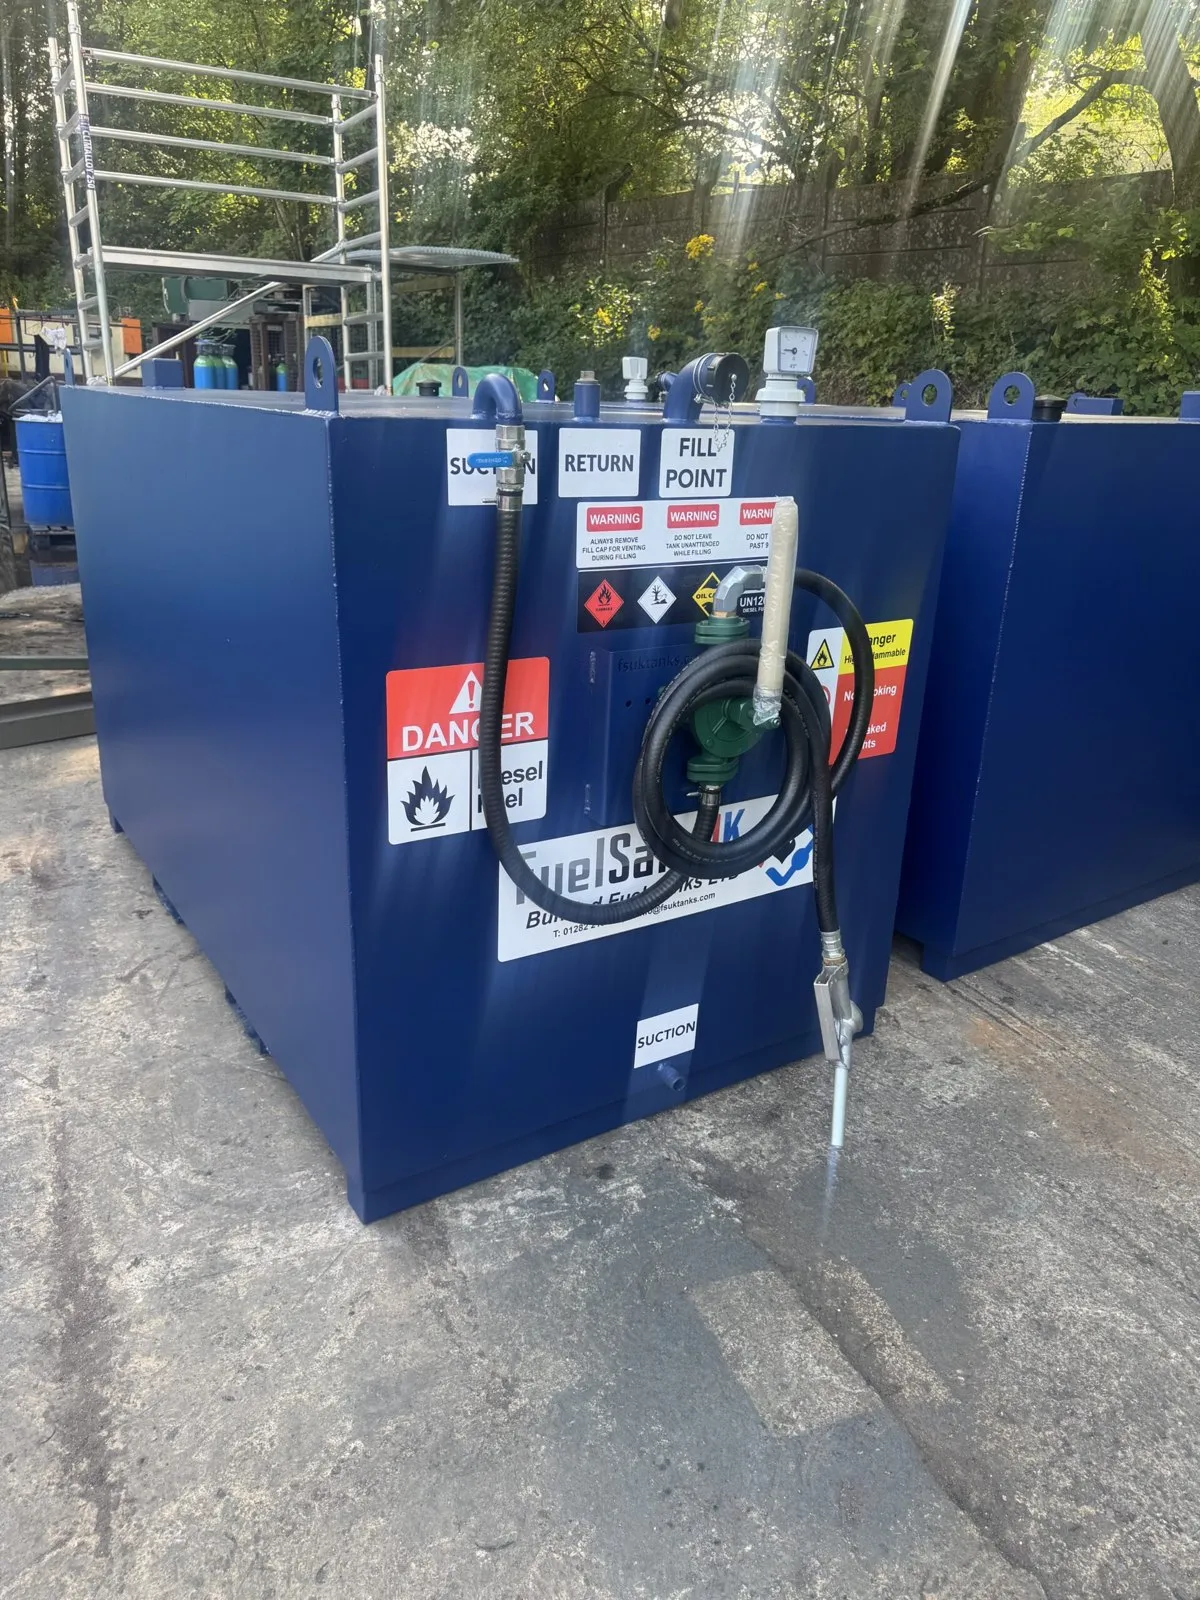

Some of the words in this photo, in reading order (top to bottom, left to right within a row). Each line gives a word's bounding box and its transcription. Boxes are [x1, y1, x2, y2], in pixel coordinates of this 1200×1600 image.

[82, 130, 94, 174] CLIMALLOY
[86, 174, 95, 189] 250
[679, 437, 717, 457] FILL
[565, 454, 634, 472] RETURN
[665, 468, 727, 489] POINT
[589, 513, 640, 525] WARNING
[670, 510, 717, 522] WARNING
[742, 508, 774, 519] WARNI
[590, 537, 614, 545] ALWAYS
[614, 536, 639, 544] REMOVE
[683, 533, 695, 541] NOT
[614, 552, 637, 560] FILLING
[673, 549, 691, 557] WHILE
[739, 595, 766, 607] UN12
[873, 684, 897, 697] oking
[866, 721, 887, 735] aked
[553, 929, 561, 937] T:
[563, 923, 588, 935] 01282
[637, 1020, 696, 1049] SUCTION
